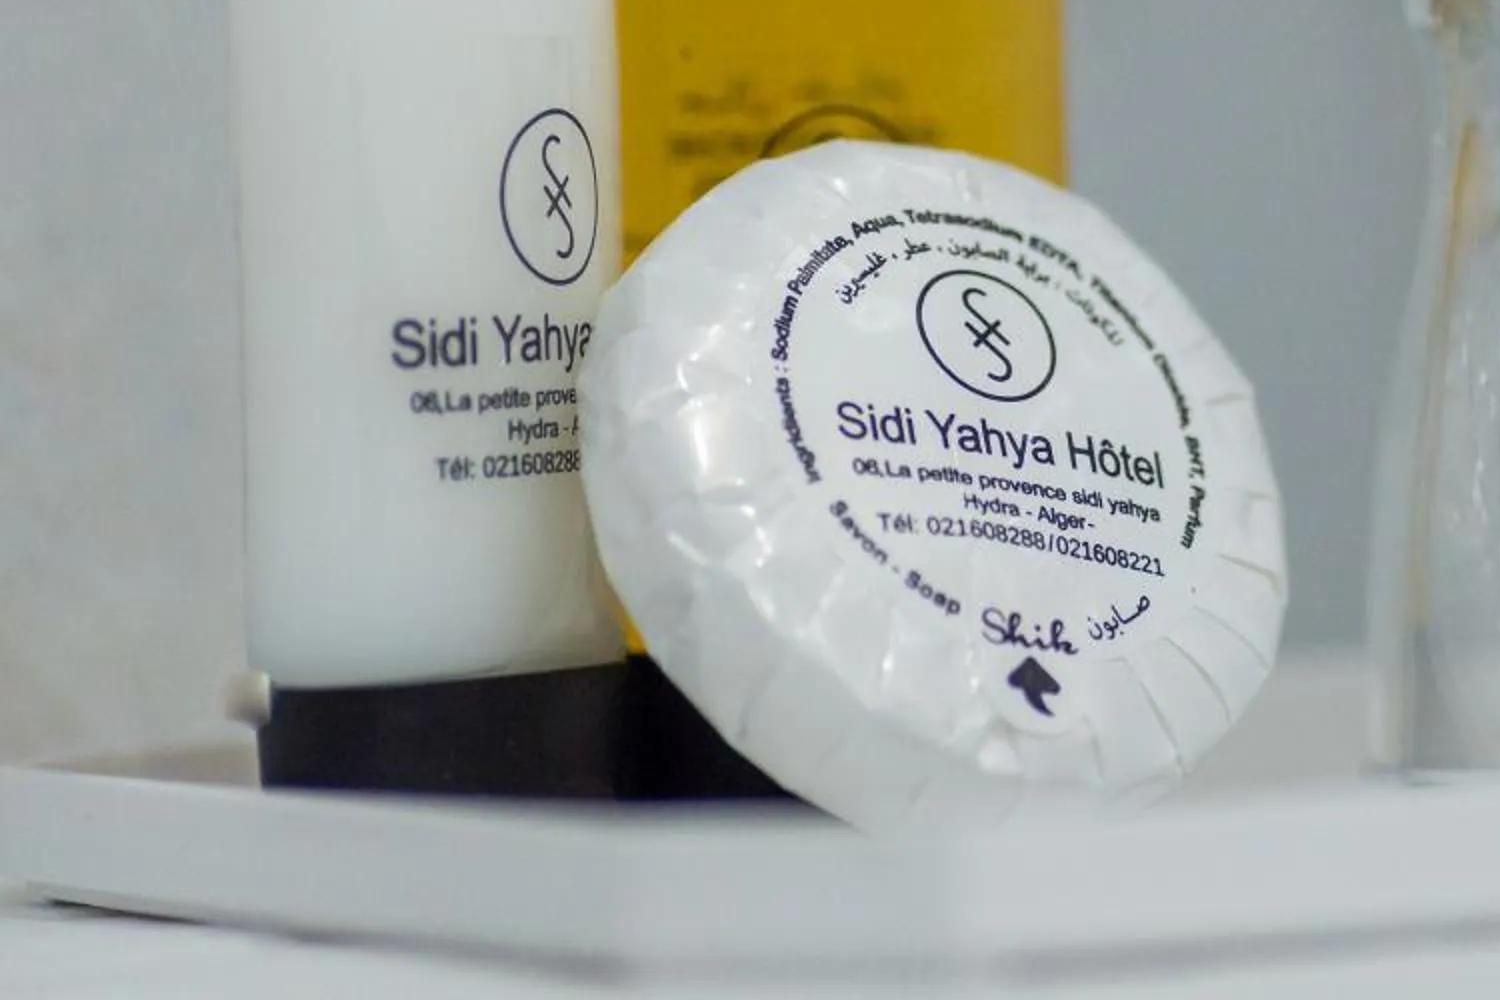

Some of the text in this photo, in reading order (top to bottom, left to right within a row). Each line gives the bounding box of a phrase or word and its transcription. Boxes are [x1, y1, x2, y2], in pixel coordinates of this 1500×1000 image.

[391, 317, 477, 370] Sidi
[771, 295, 798, 361] Sodium
[478, 387, 530, 414] petite
[536, 387, 577, 412] prove
[508, 417, 559, 445] Hydra
[837, 401, 1164, 488] Sidi Yahya Hôtel
[918, 465, 973, 485] petite
[979, 474, 1066, 501] provence
[1072, 488, 1103, 509] sidi
[1107, 496, 1161, 522] yahya
[963, 493, 1020, 517] Hydra
[878, 512, 919, 535] Tél:
[829, 500, 889, 565] Savon
[904, 569, 961, 616] Soap
[981, 607, 1079, 655] Shik
[1087, 595, 1150, 641] صابون
